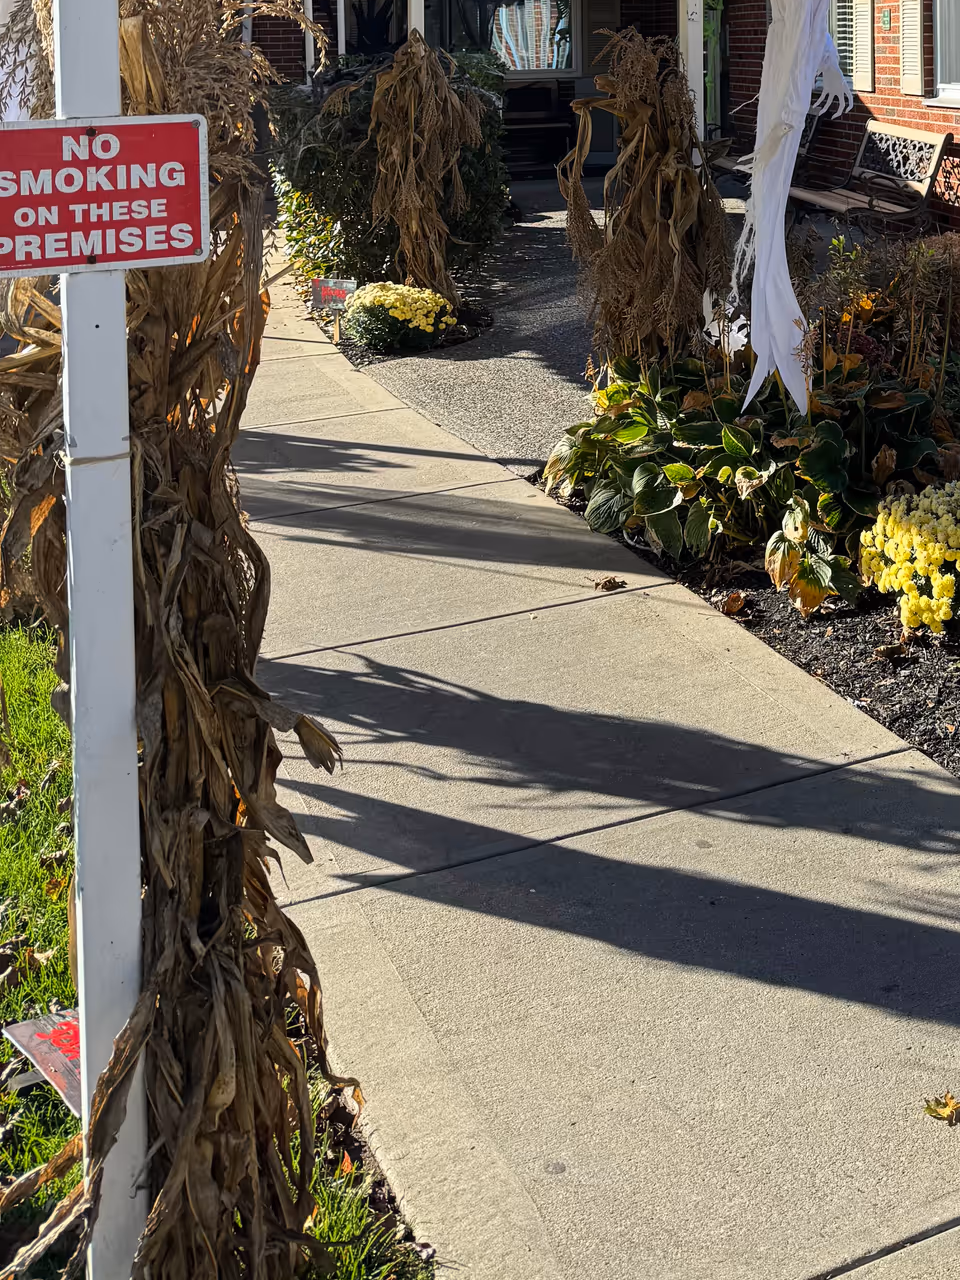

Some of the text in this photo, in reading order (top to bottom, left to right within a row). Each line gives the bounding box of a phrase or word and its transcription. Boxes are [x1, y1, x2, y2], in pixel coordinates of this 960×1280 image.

[62, 133, 121, 162] NO
[0, 161, 186, 198] SMOKING
[13, 198, 168, 228] ON THESE
